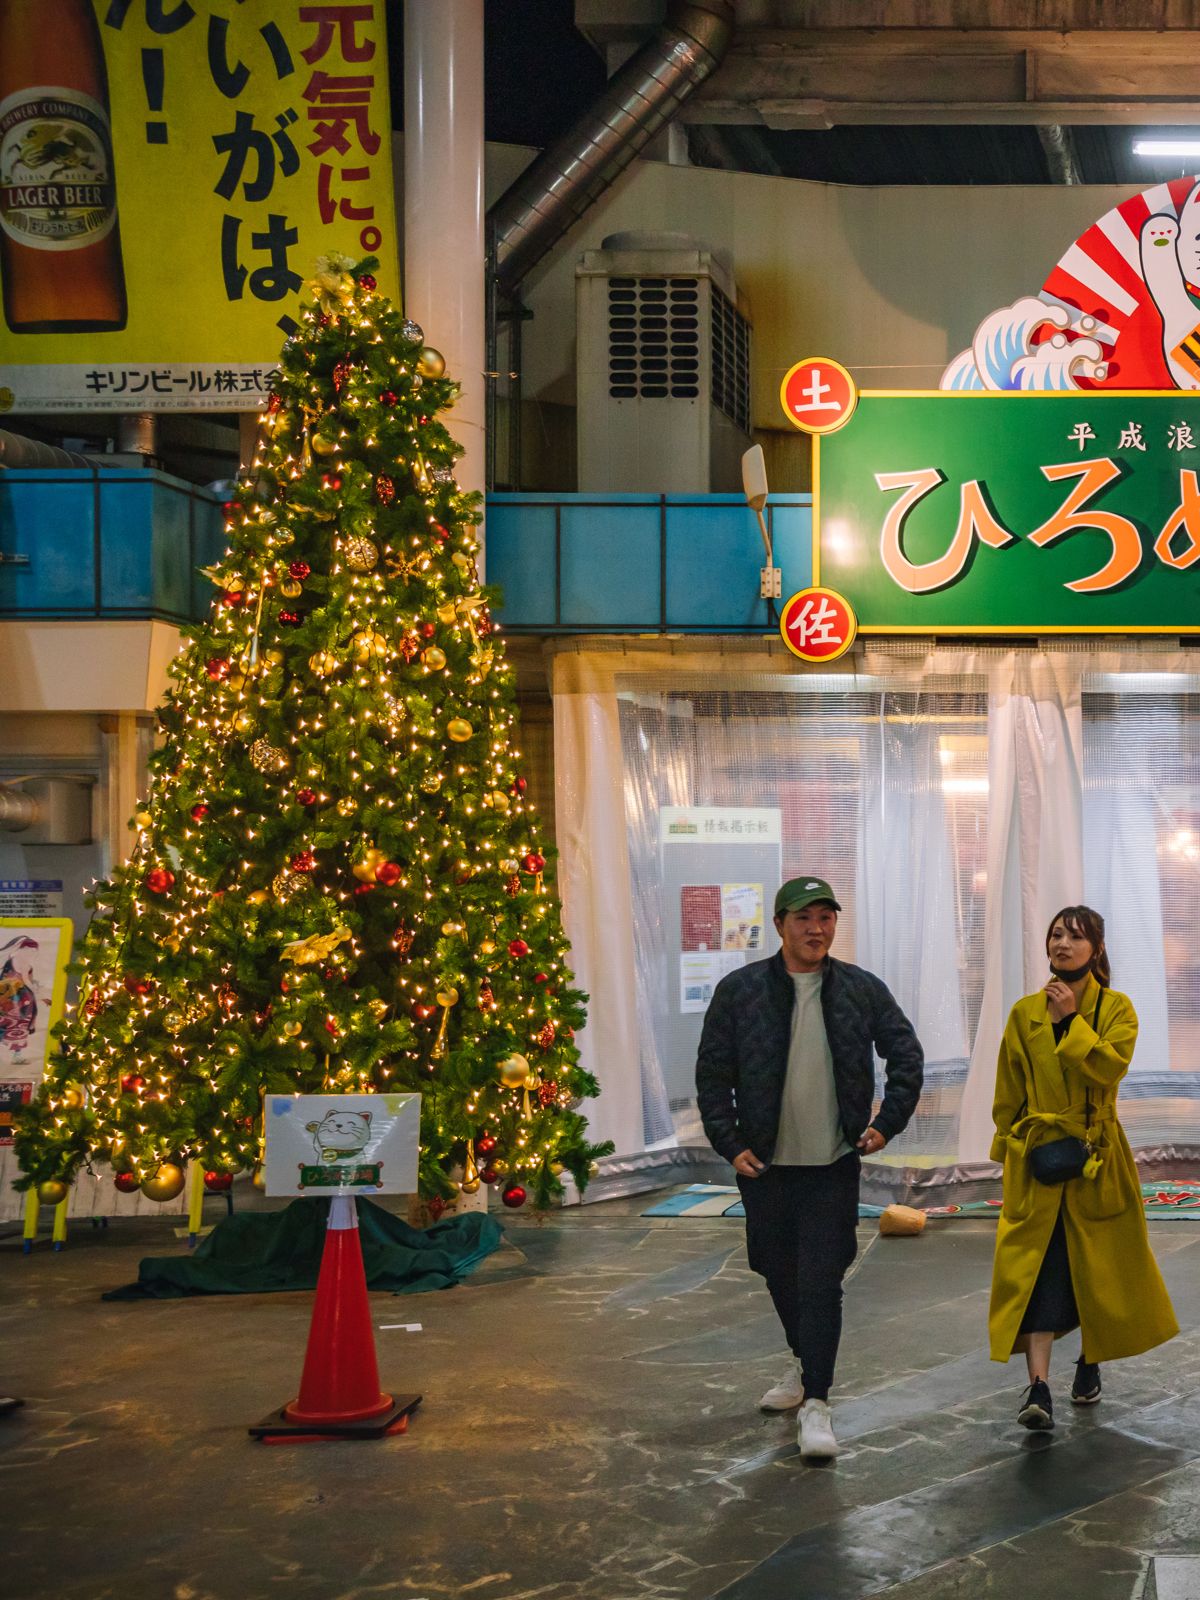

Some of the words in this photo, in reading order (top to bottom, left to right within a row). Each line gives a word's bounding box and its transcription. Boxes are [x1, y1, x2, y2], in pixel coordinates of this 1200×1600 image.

[9, 187, 60, 207] LAGER
[64, 187, 103, 205] BEER
[794, 369, 843, 414] 土
[789, 599, 842, 648] 佐
